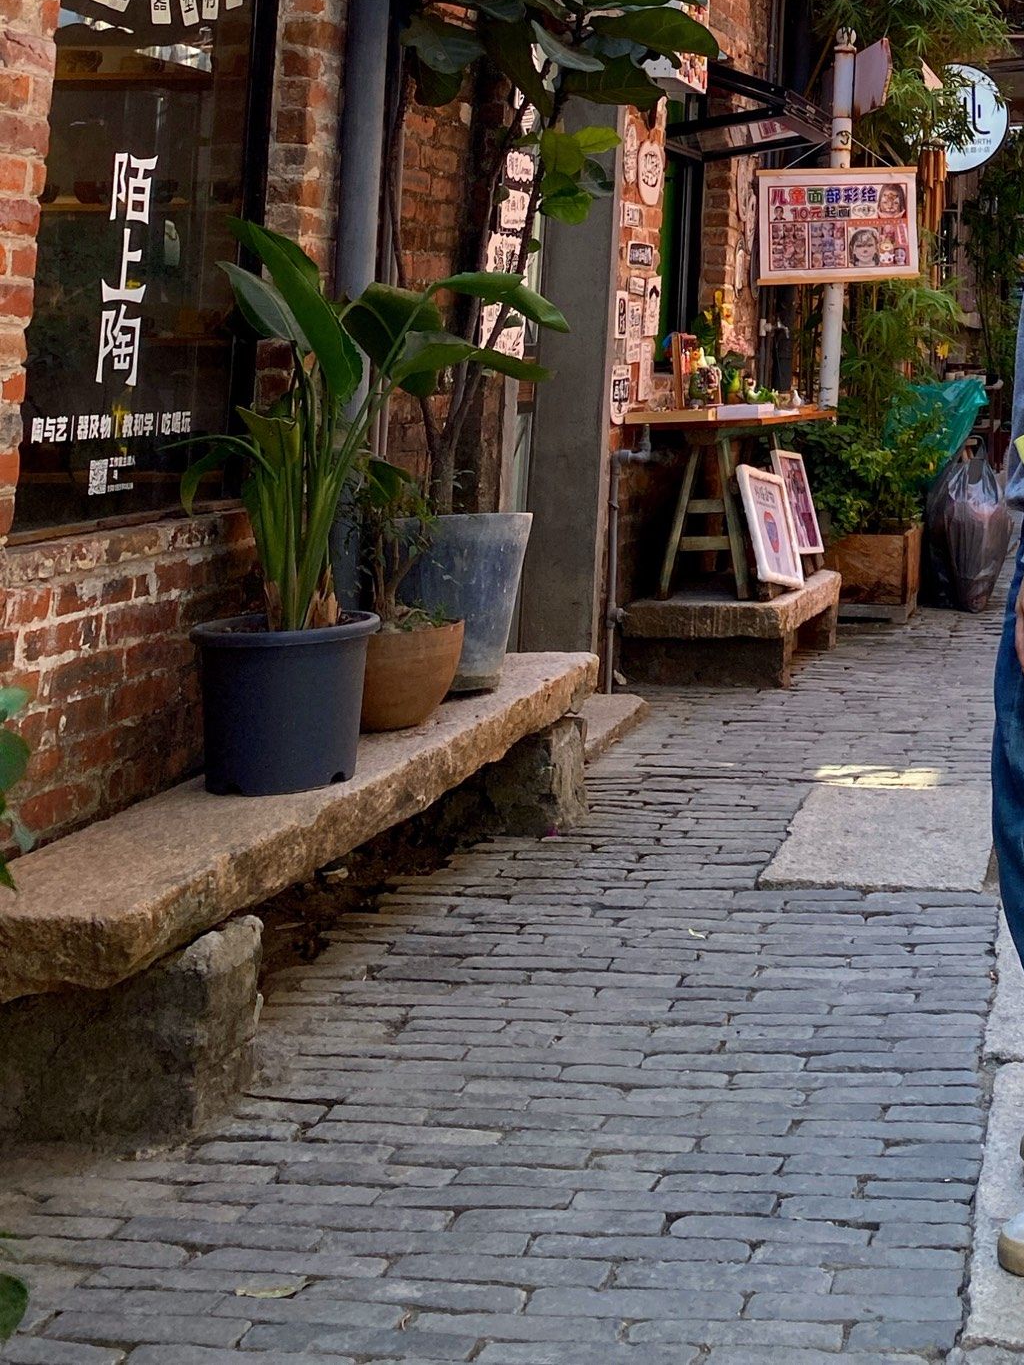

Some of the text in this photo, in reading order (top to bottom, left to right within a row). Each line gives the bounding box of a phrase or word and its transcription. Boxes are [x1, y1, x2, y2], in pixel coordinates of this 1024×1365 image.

[770, 186, 878, 206] 儿童面部彩绘
[790, 205, 851, 219] 10元起画
[95, 152, 159, 386] 陌上陶
